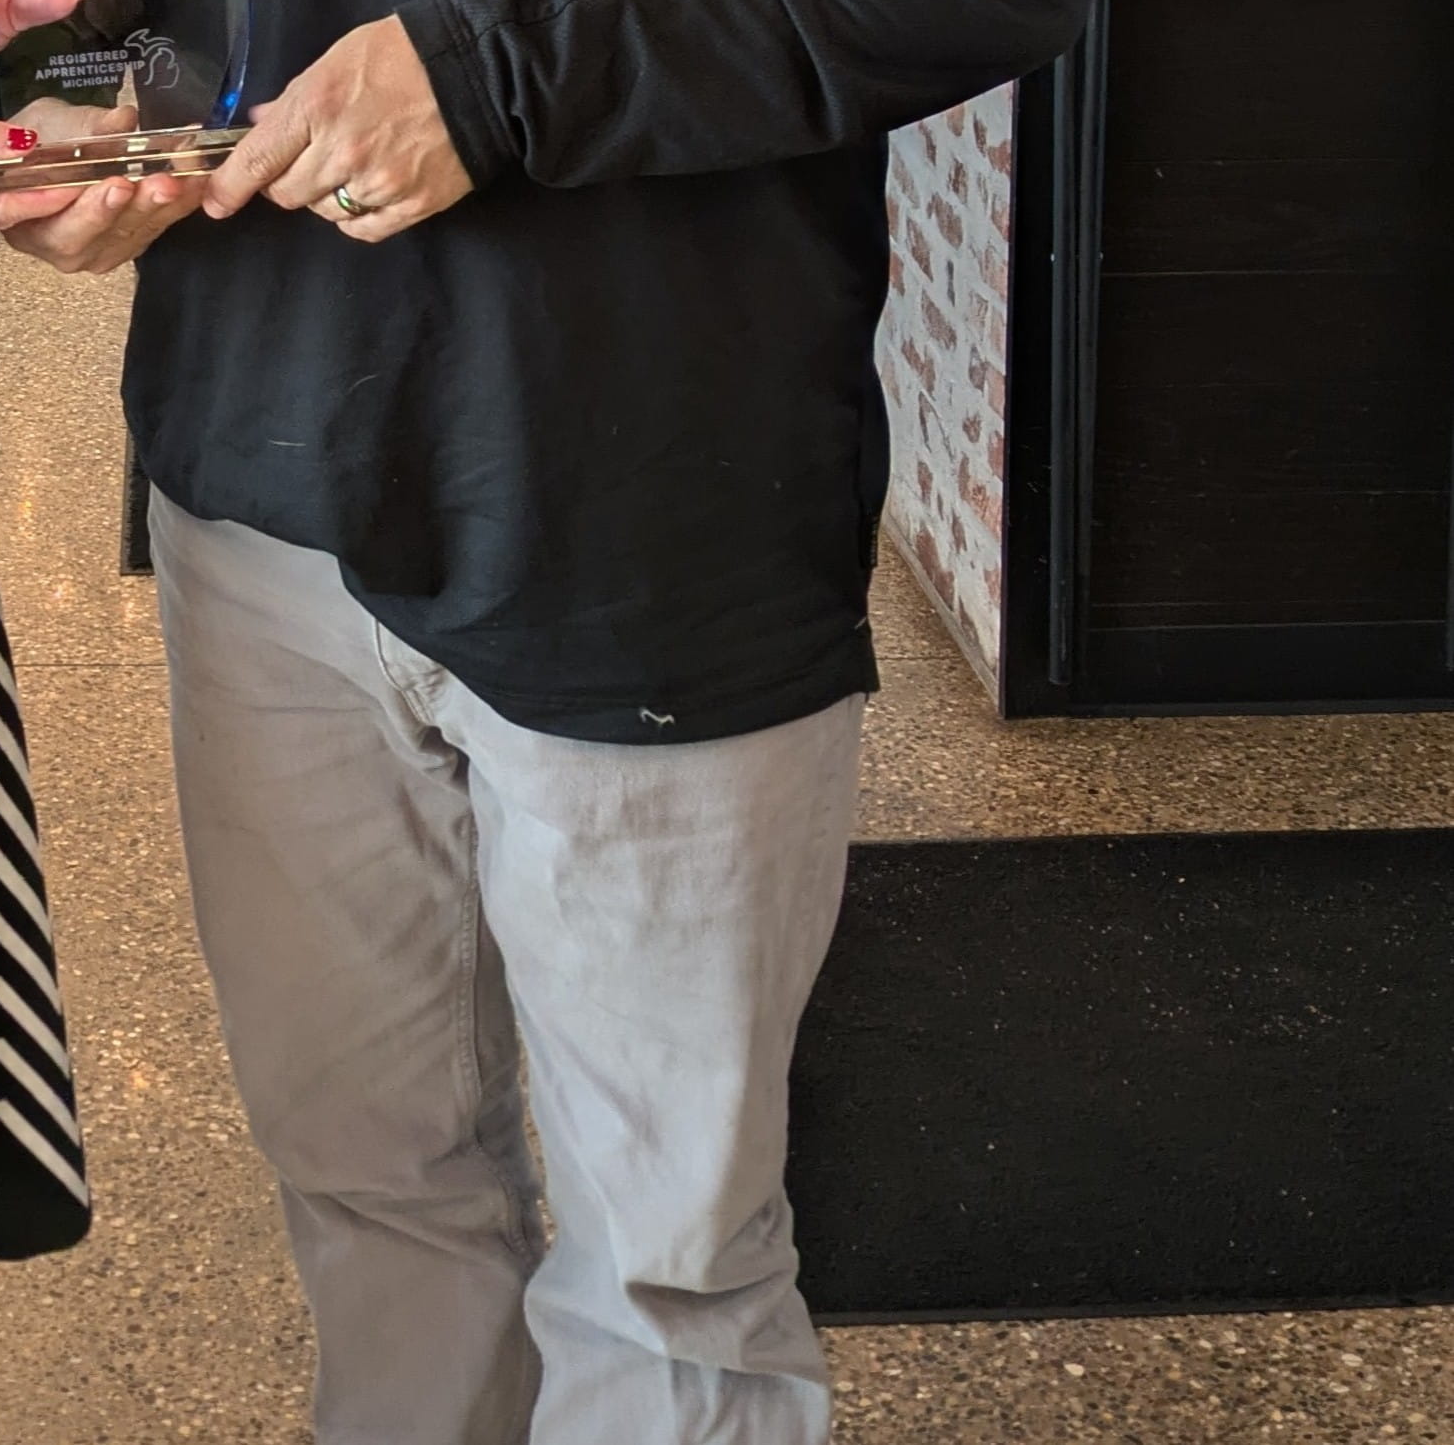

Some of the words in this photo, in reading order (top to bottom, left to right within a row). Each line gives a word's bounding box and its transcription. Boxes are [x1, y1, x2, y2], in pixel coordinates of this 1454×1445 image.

[49, 49, 129, 67] REGISTERED
[34, 60, 146, 81] APPRENTICESHIP
[62, 75, 119, 89] MICHIGAN
